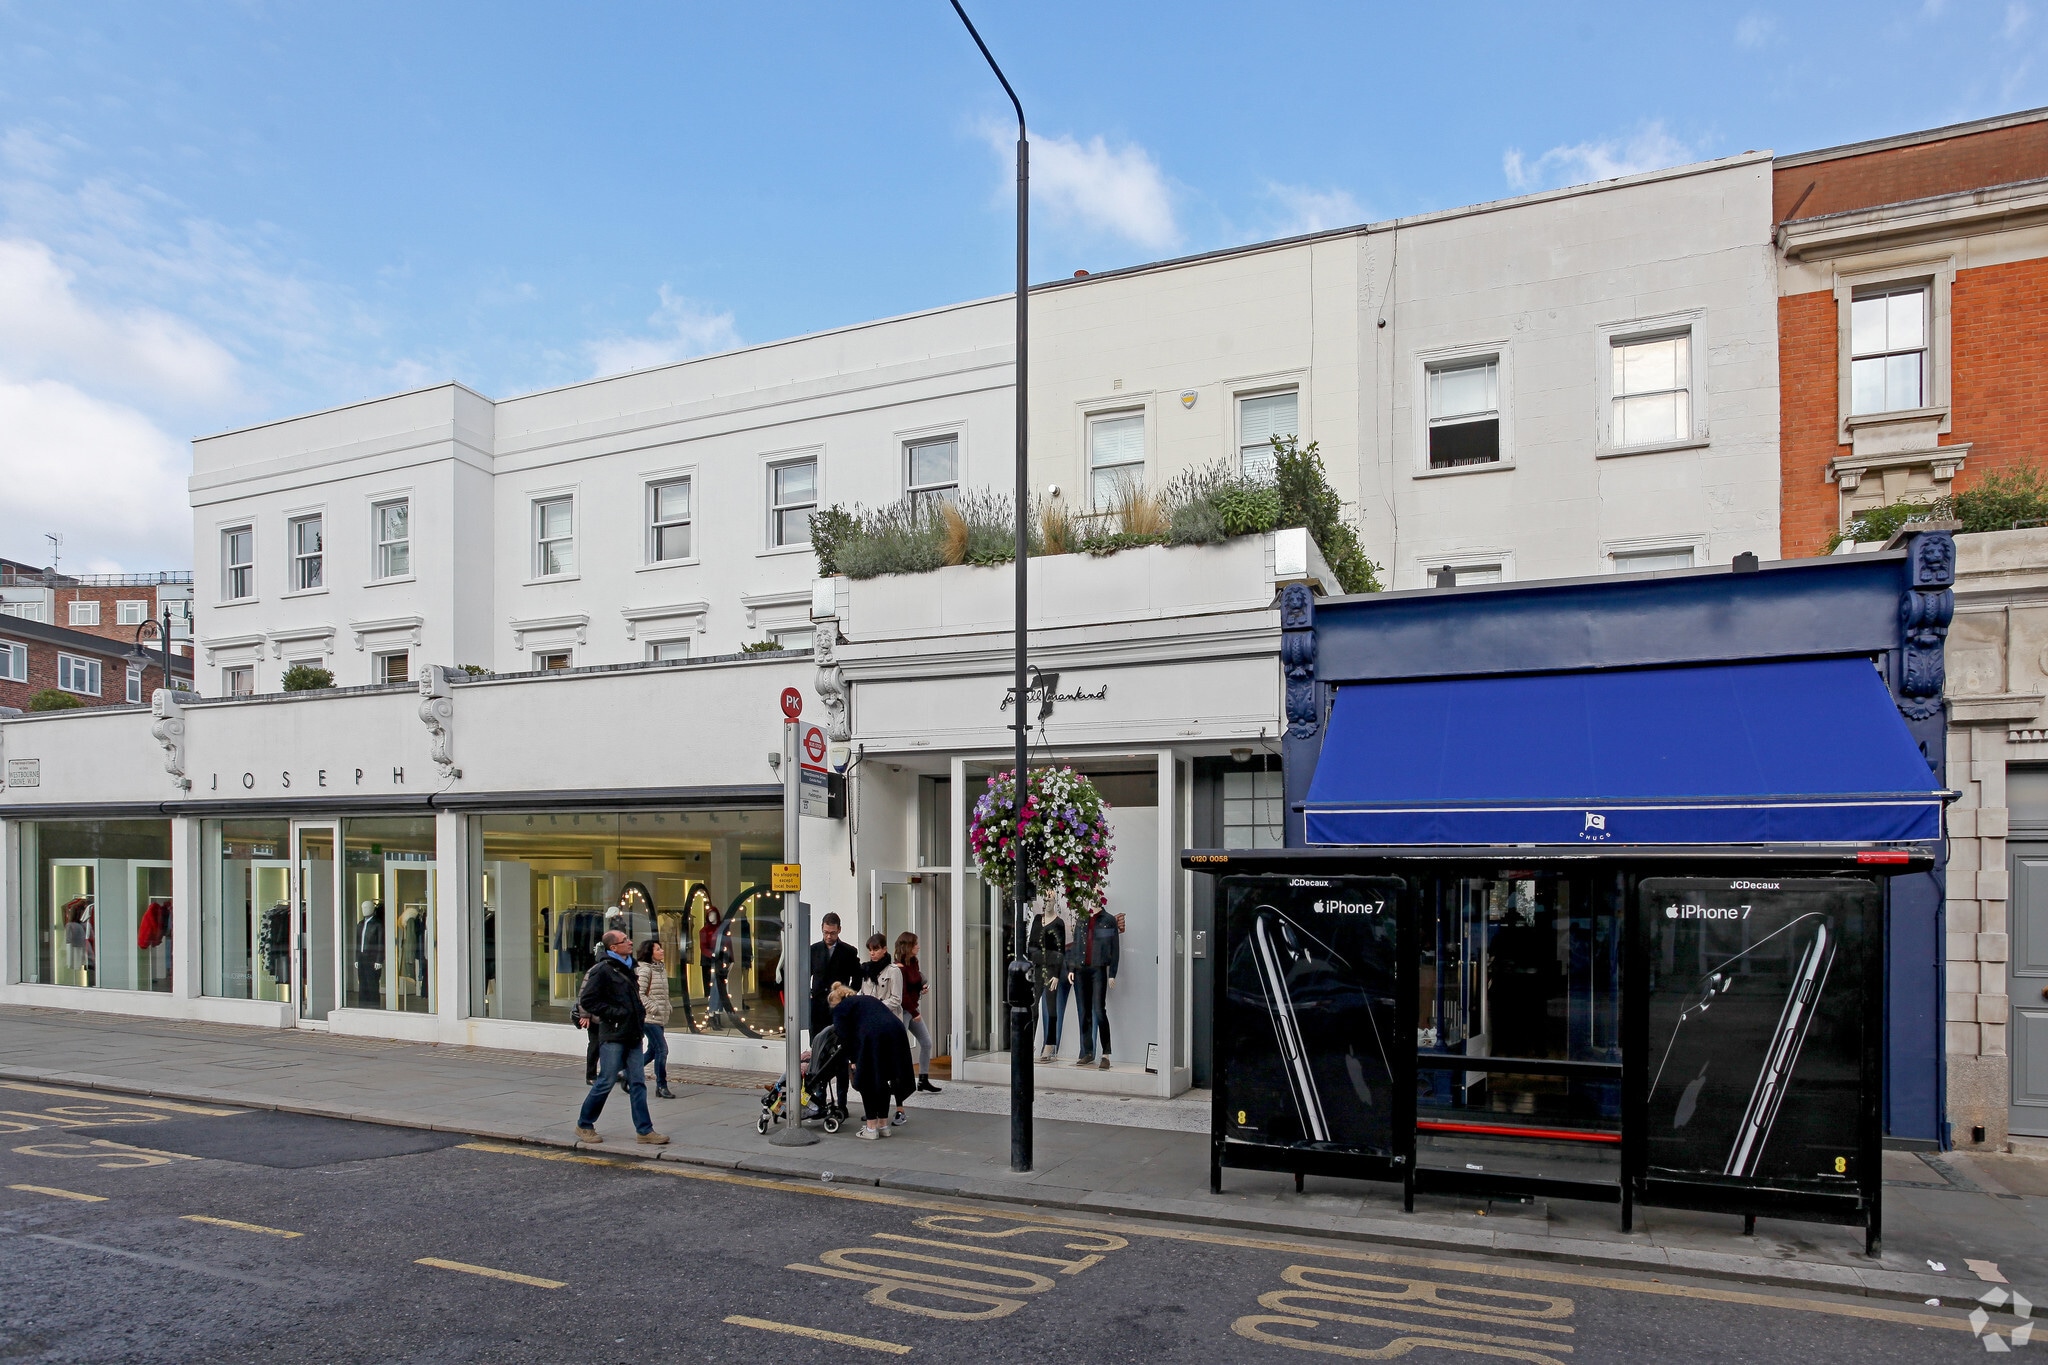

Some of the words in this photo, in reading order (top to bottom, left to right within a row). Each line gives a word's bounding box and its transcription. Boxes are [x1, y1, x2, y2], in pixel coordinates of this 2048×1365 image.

[1046, 684, 1108, 703] mankind
[786, 695, 800, 710] PK
[211, 766, 405, 791] JOSEPH
[1591, 815, 1601, 826] C
[1190, 855, 1207, 863] 0120
[1209, 855, 1229, 863] 0058
[1289, 879, 1329, 887] JCDecaux
[1730, 881, 1780, 890] JCDecaux
[1326, 900, 1373, 914] iPhone
[1375, 901, 1385, 914] 7
[1681, 904, 1739, 919] iPhone
[1741, 905, 1752, 920] 7
[785, 1215, 1129, 1321] STOP
[1230, 1264, 1576, 1365] BUS
